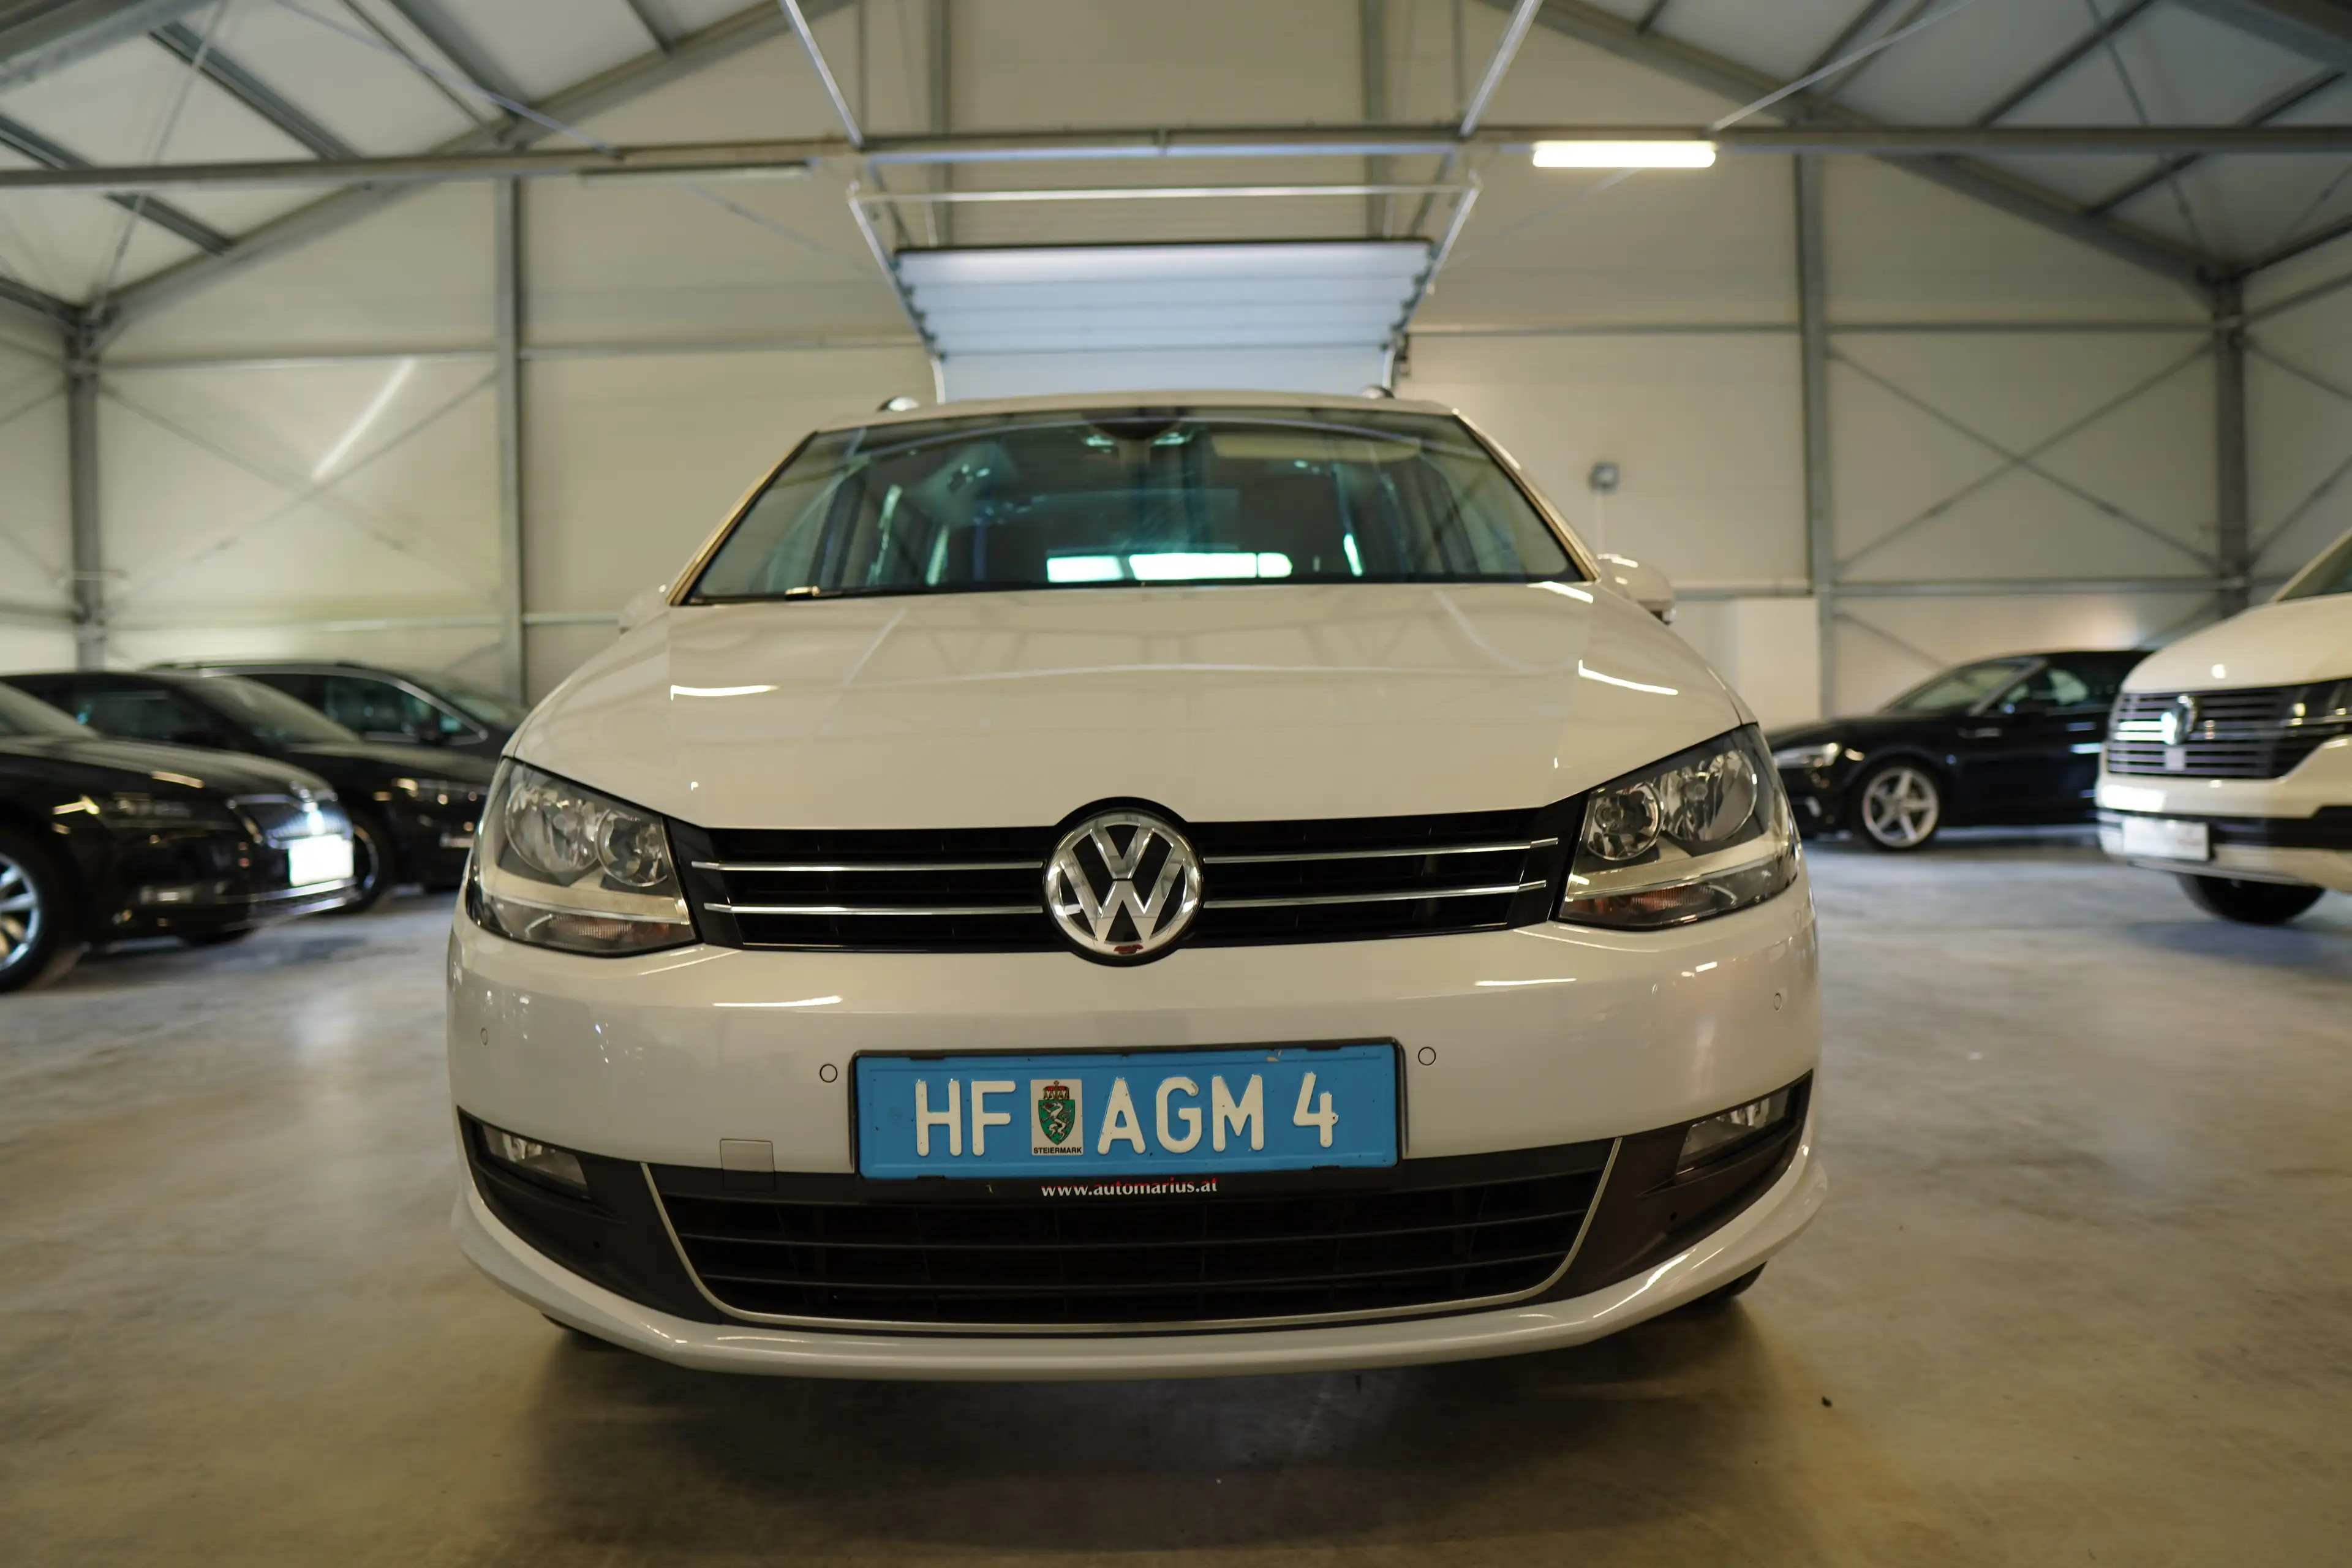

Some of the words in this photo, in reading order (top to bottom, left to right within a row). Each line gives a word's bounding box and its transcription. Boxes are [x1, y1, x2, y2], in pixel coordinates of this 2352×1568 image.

[1049, 813, 1199, 953] VW
[915, 1079, 1016, 1157] HF
[1096, 1072, 1265, 1155] AGM
[1292, 1071, 1340, 1148] 4
[1041, 1177, 1218, 1196] www.automarius.at
